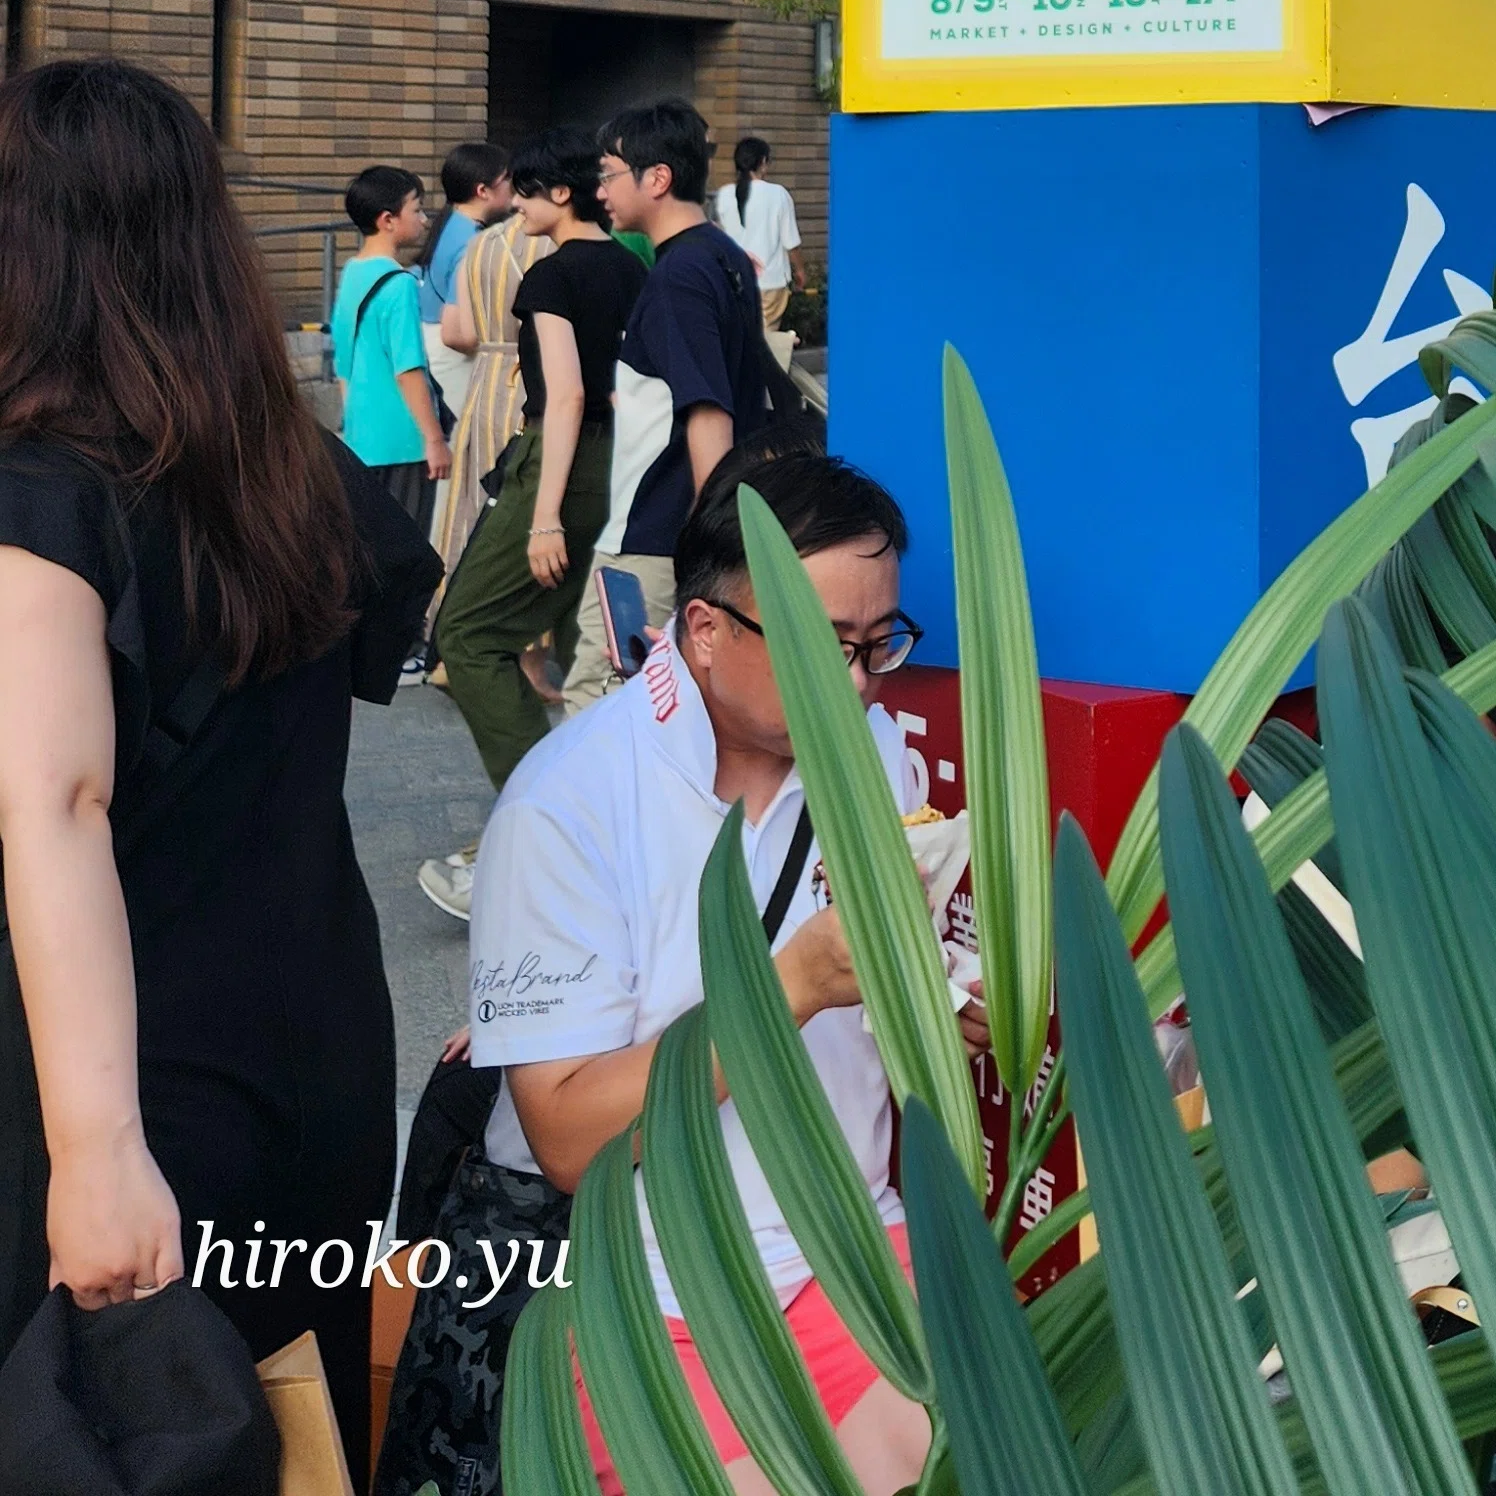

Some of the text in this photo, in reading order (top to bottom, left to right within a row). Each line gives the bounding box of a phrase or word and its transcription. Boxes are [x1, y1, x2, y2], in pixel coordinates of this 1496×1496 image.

[930, 25, 1009, 40] MARKET
[1038, 22, 1113, 36] DESIGN
[1143, 18, 1237, 33] CULTURE
